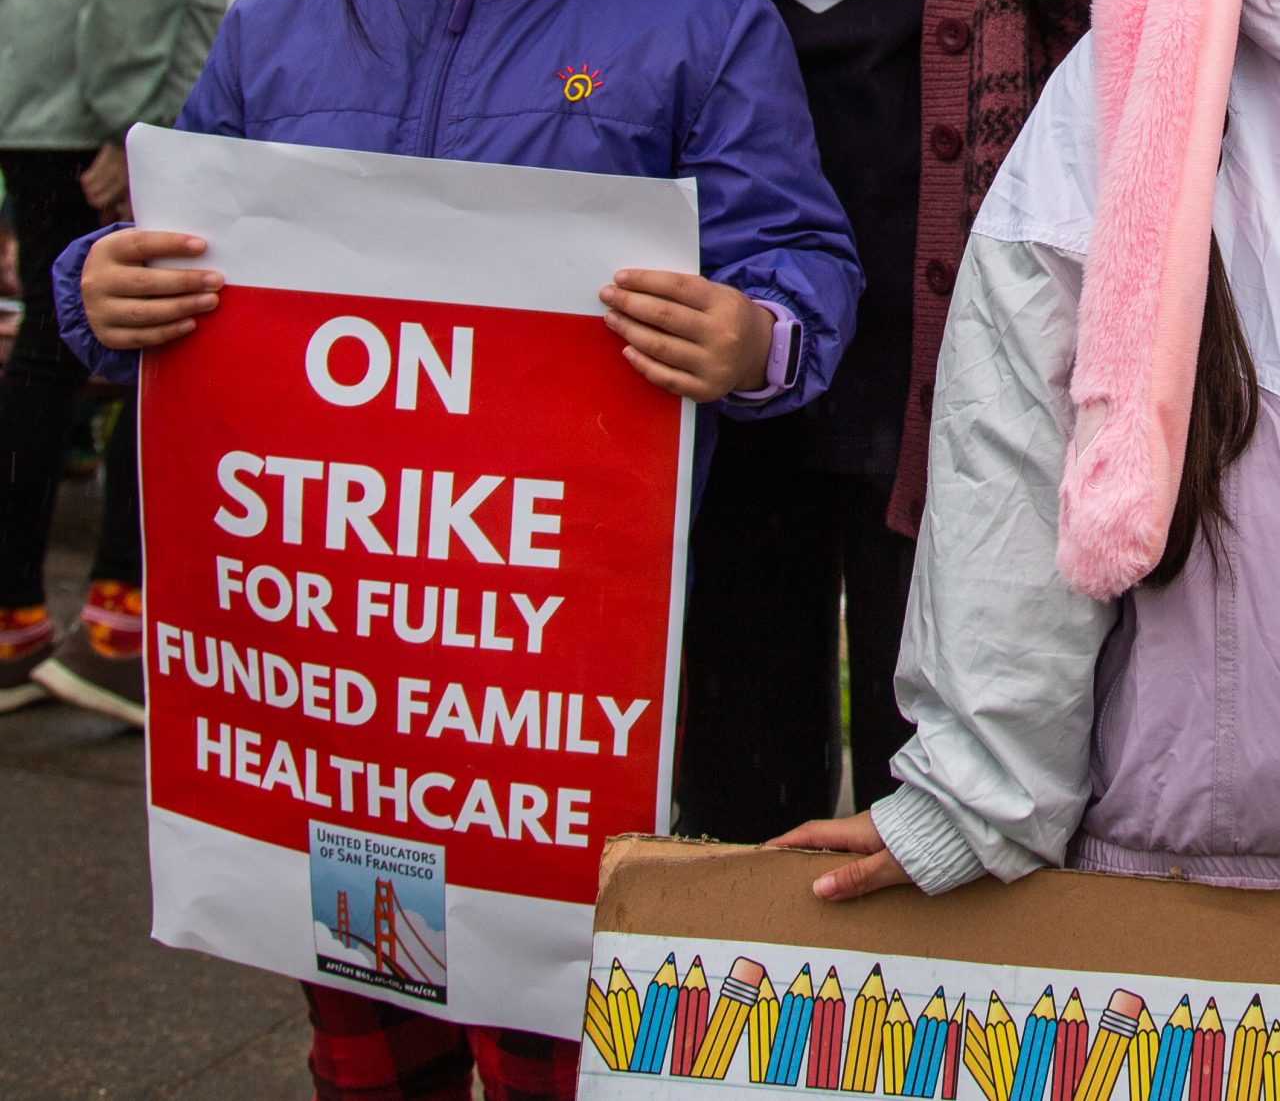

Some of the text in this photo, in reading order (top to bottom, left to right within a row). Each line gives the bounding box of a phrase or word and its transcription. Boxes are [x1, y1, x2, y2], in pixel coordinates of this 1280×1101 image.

[304, 315, 475, 415] ON
[214, 449, 566, 570] STRIKE
[216, 555, 566, 654] FOR FULLY
[156, 621, 651, 758] FUNDED FAMILY
[195, 717, 591, 848] HEALTHCARE
[317, 828, 437, 865] UNITED EDUCATORS
[337, 848, 362, 865] SAN
[366, 854, 434, 880] FRANCISCO
